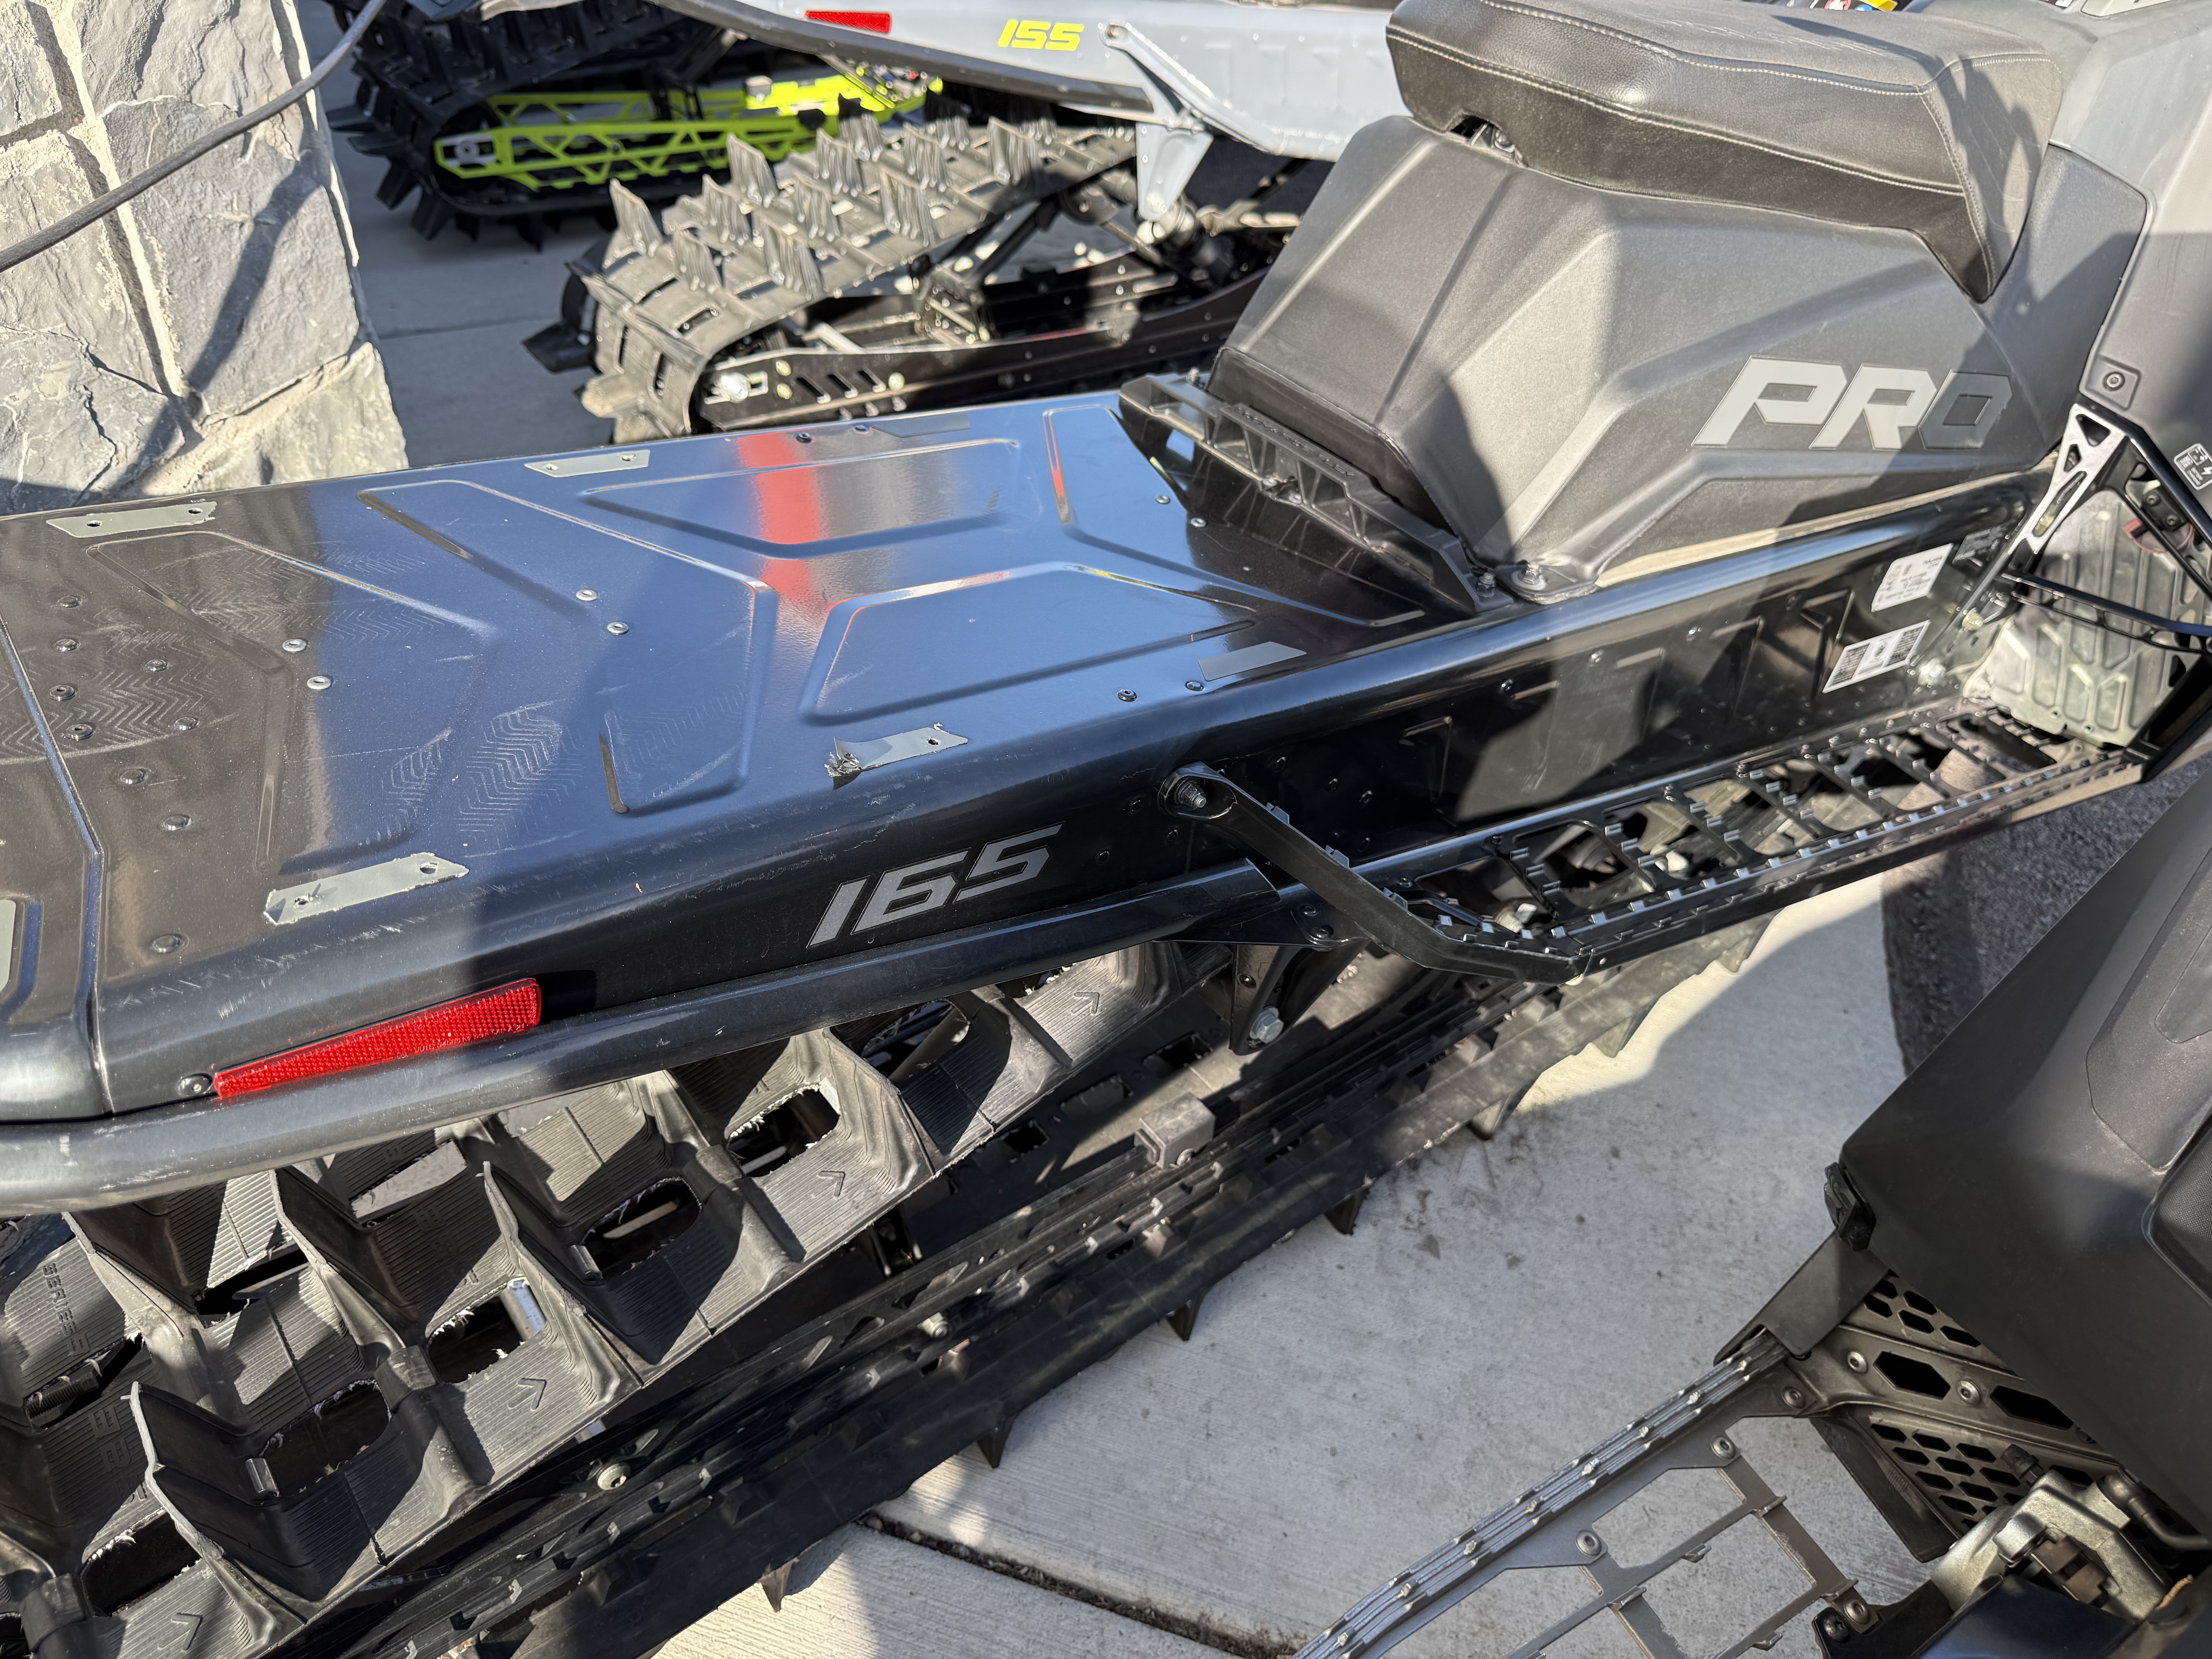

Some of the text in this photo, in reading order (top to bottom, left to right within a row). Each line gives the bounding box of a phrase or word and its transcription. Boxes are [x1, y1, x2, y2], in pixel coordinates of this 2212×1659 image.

[998, 19, 1084, 51] 155
[1691, 355, 2012, 449] PRO
[807, 821, 1065, 948] 165
[43, 1262, 76, 1336] SERIES
